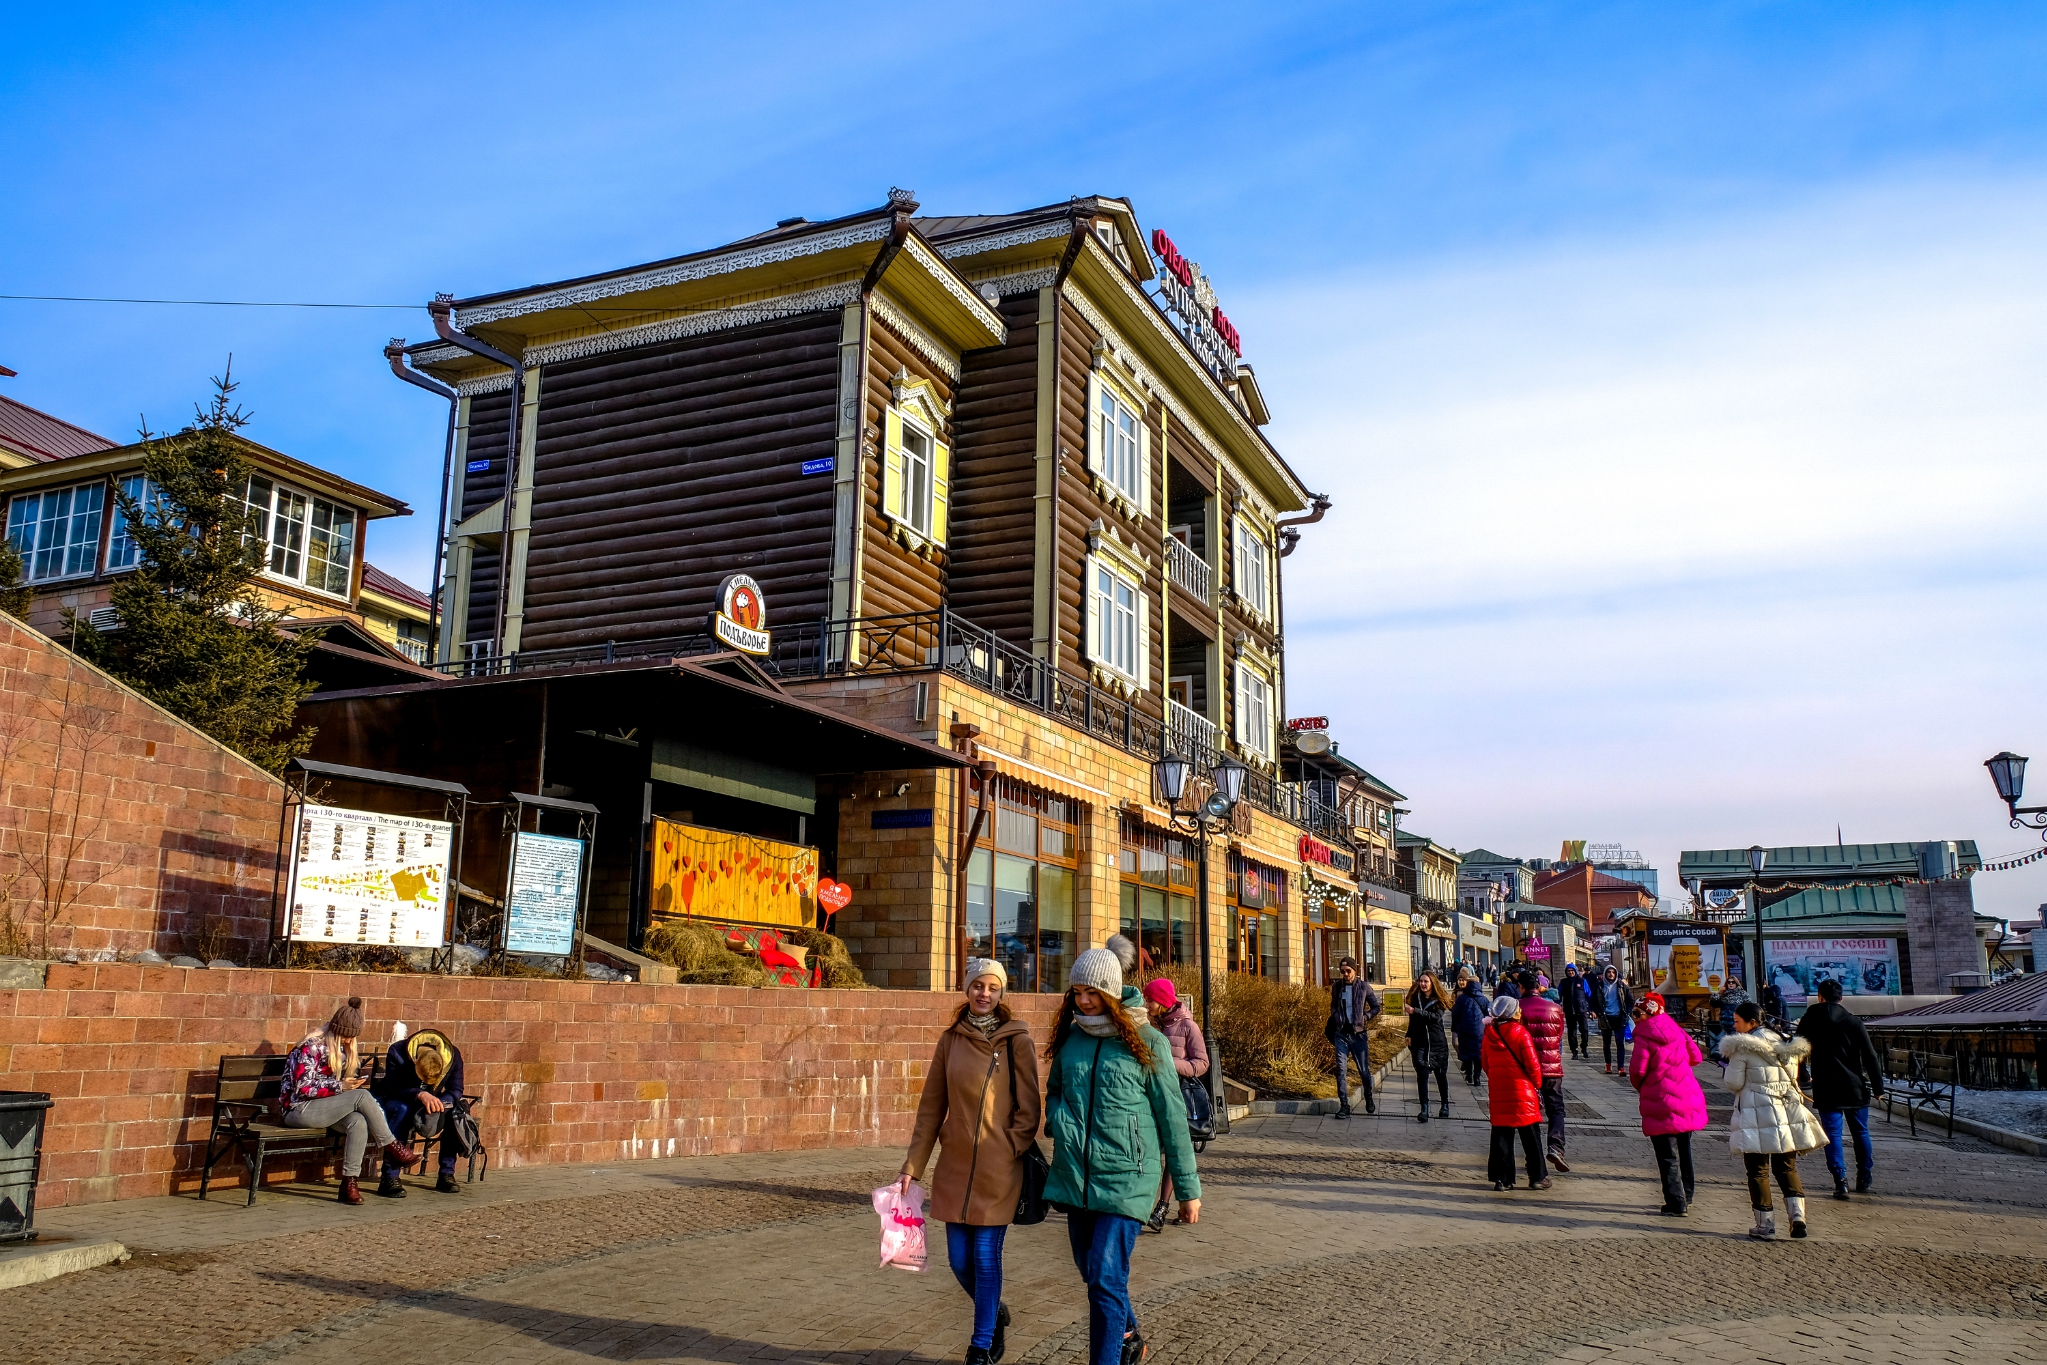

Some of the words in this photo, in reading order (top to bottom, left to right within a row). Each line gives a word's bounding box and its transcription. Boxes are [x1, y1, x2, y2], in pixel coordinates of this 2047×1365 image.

[1154, 229, 1192, 286] ОТЕЛЬ
[1213, 306, 1242, 358] HOTEL
[729, 576, 762, 599] ХМЕЛЬНОЕ
[720, 619, 766, 650] ПОДЪВОРЬЕ
[378, 816, 389, 824] The
[389, 819, 403, 827] map
[403, 819, 411, 827] of
[882, 814, 912, 824] Седова
[1589, 850, 1642, 860] КВАРТАЛ
[1691, 928, 1717, 936] СОБОЙ
[1771, 940, 1826, 950] ПЛАТКИ
[1832, 939, 1888, 949] РОССИИ
